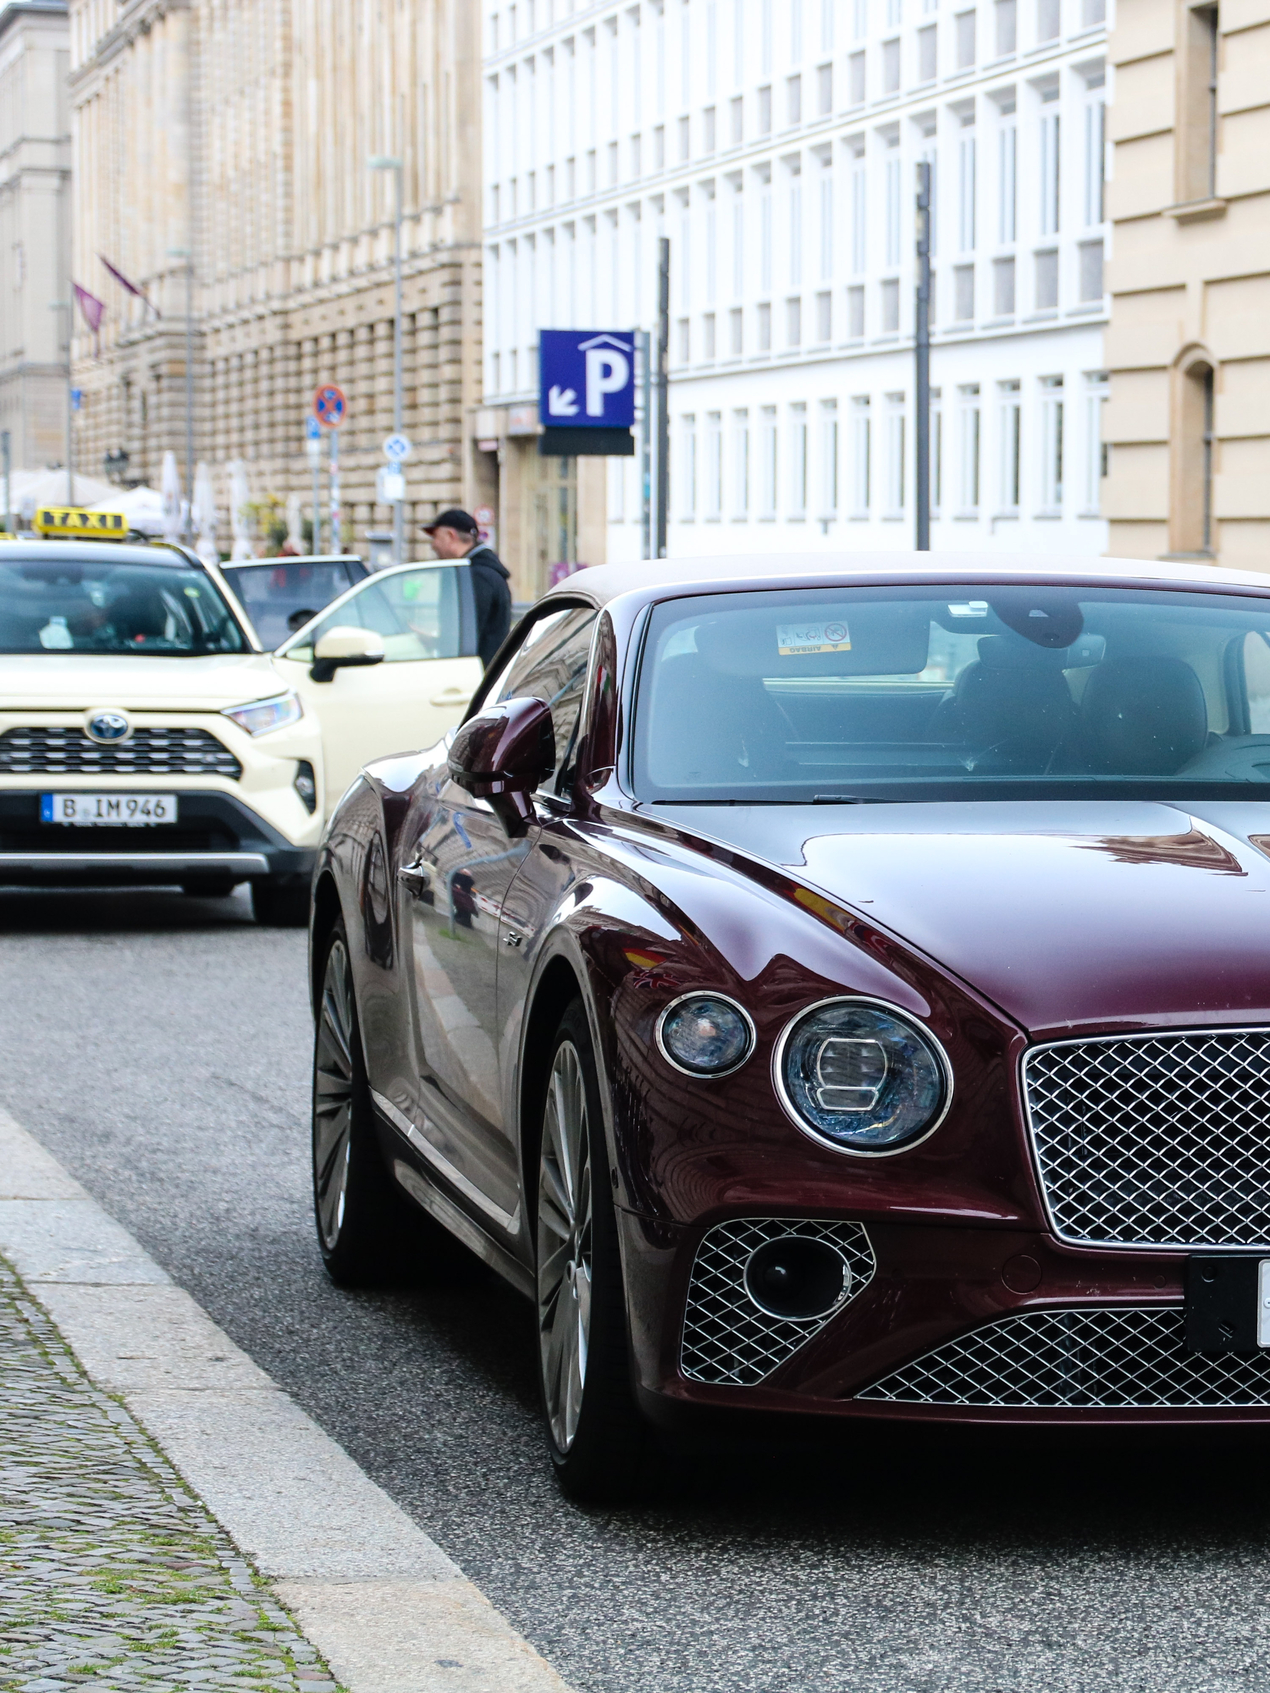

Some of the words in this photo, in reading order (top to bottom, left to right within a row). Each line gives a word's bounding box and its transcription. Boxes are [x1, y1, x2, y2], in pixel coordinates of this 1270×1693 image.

[586, 348, 630, 417] P
[51, 513, 115, 529] TAXI
[63, 799, 76, 817] B
